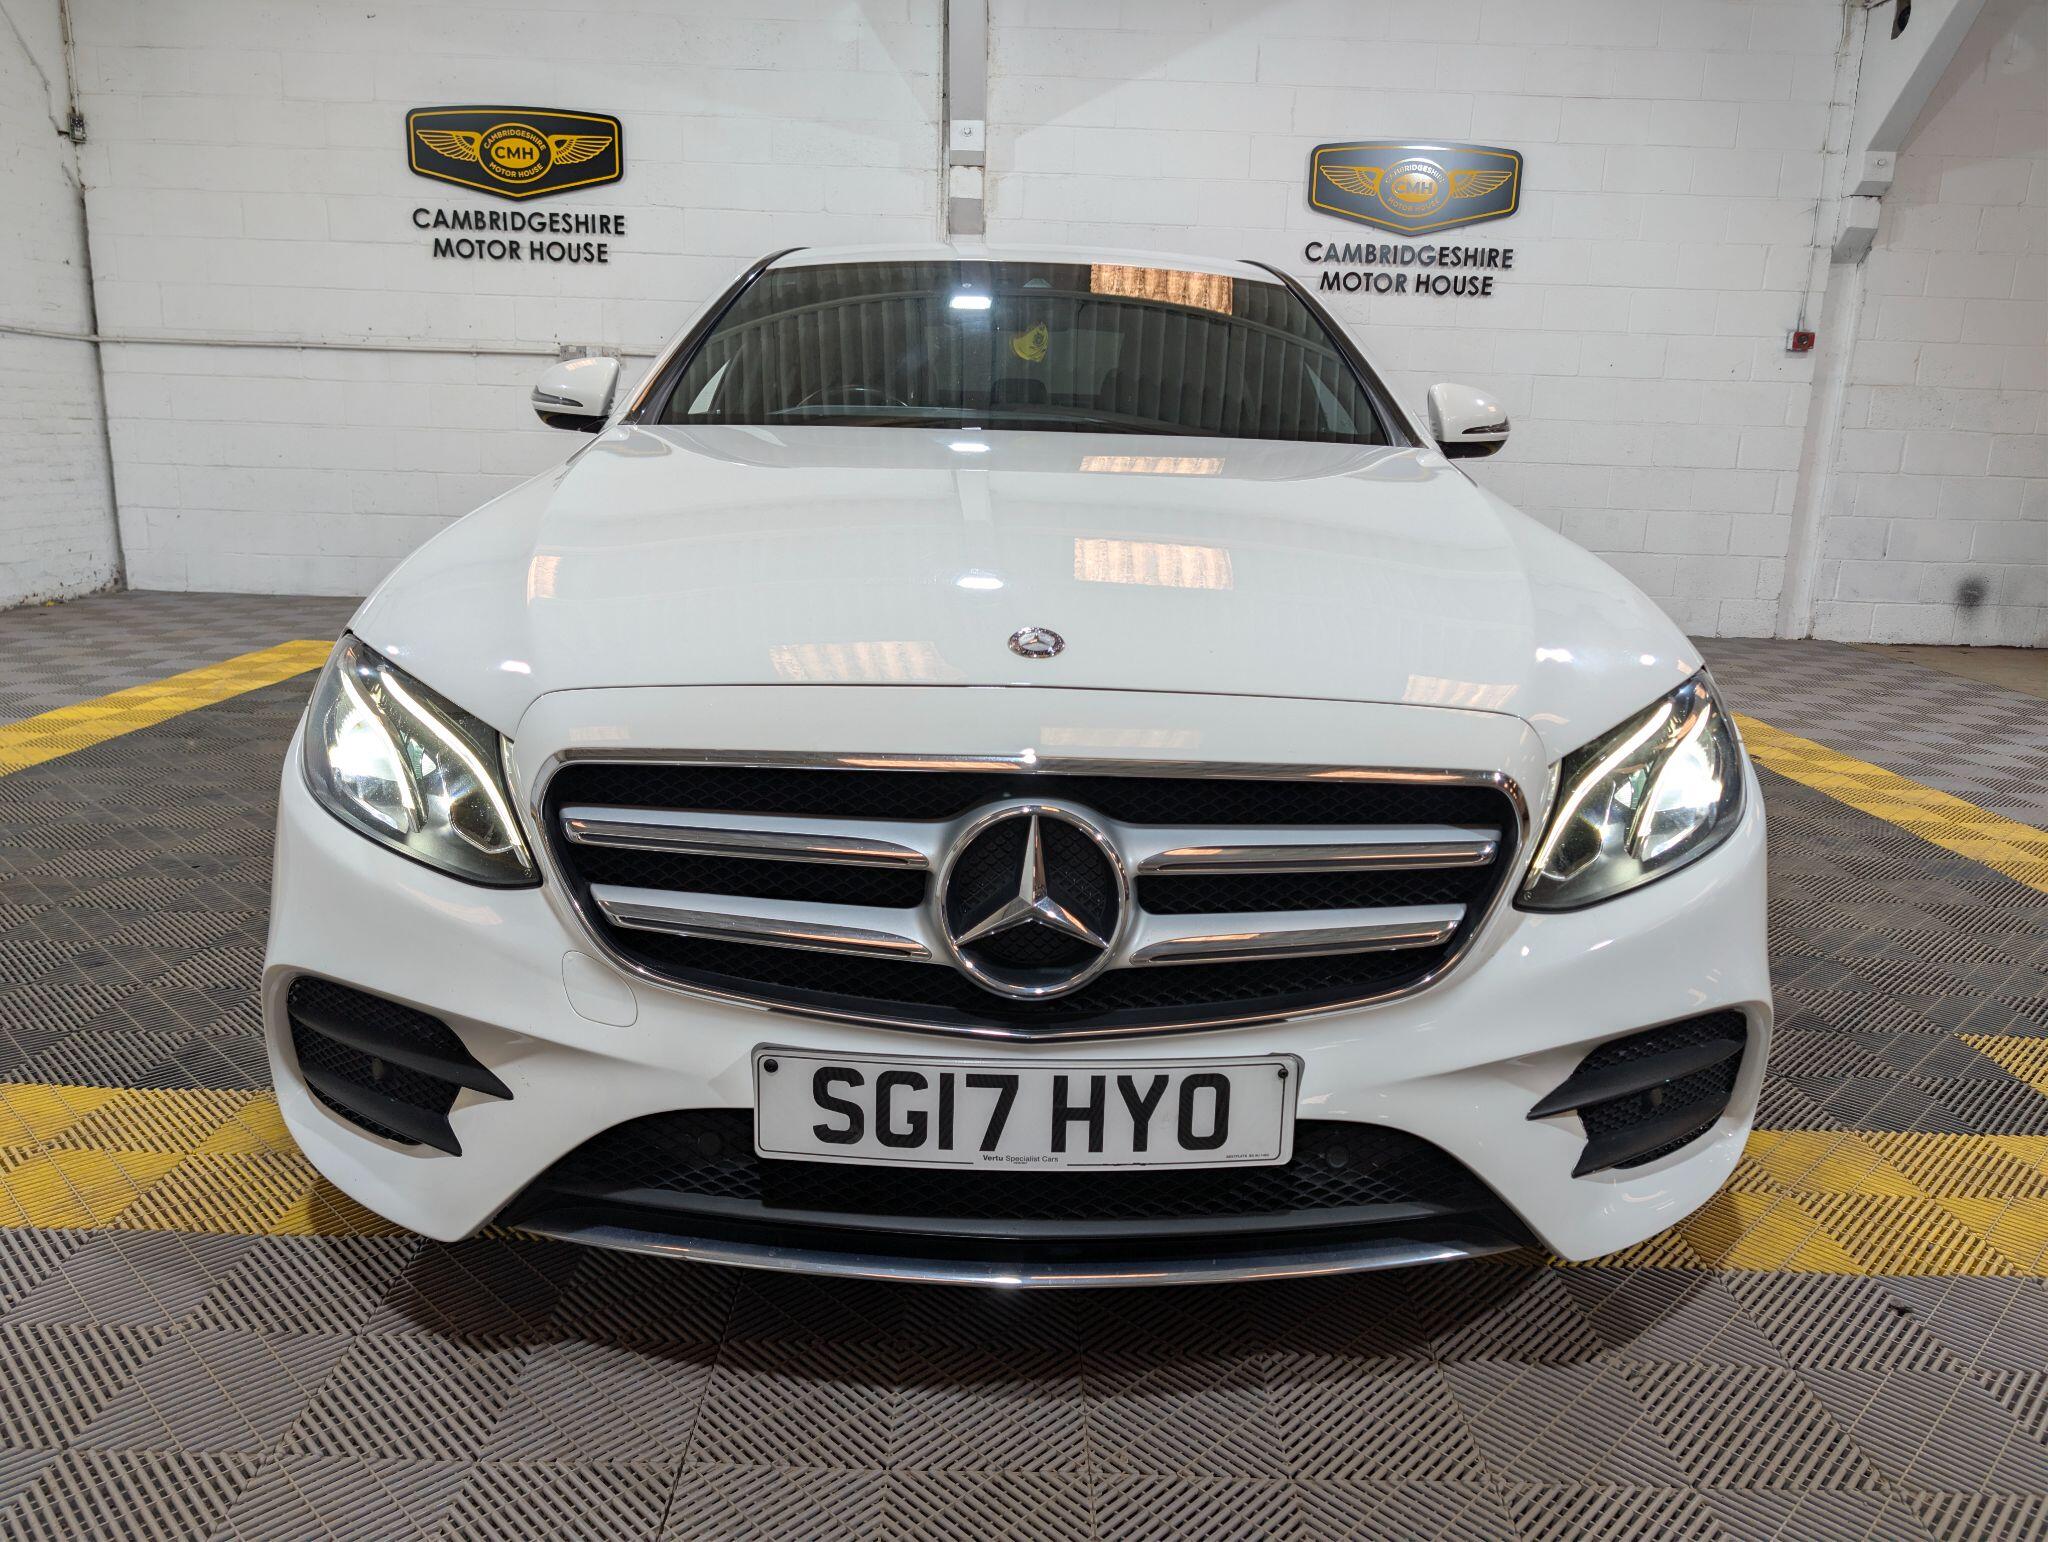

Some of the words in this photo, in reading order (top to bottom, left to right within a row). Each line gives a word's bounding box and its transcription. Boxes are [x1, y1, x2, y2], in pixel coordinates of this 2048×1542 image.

[483, 129, 547, 151] CAMBRIDGESHIRE
[494, 146, 534, 160] CMH
[489, 161, 517, 178] MOTOR
[518, 163, 544, 178] HOUSE
[1393, 181, 1433, 195] CMH
[412, 207, 626, 235] CAMBRIDGESHIRE
[433, 238, 521, 261] MOTOR
[530, 241, 609, 263] HOUSE
[1304, 241, 1514, 269] CAMBRIDGESHIRE
[1319, 271, 1408, 294] MOTOR
[1415, 273, 1494, 296] HOUSE
[812, 1066, 1020, 1153] SG17
[1051, 1073, 1231, 1153] HYO
[1005, 1154, 1040, 1163] Specialist
[1041, 1155, 1059, 1163] Cars
